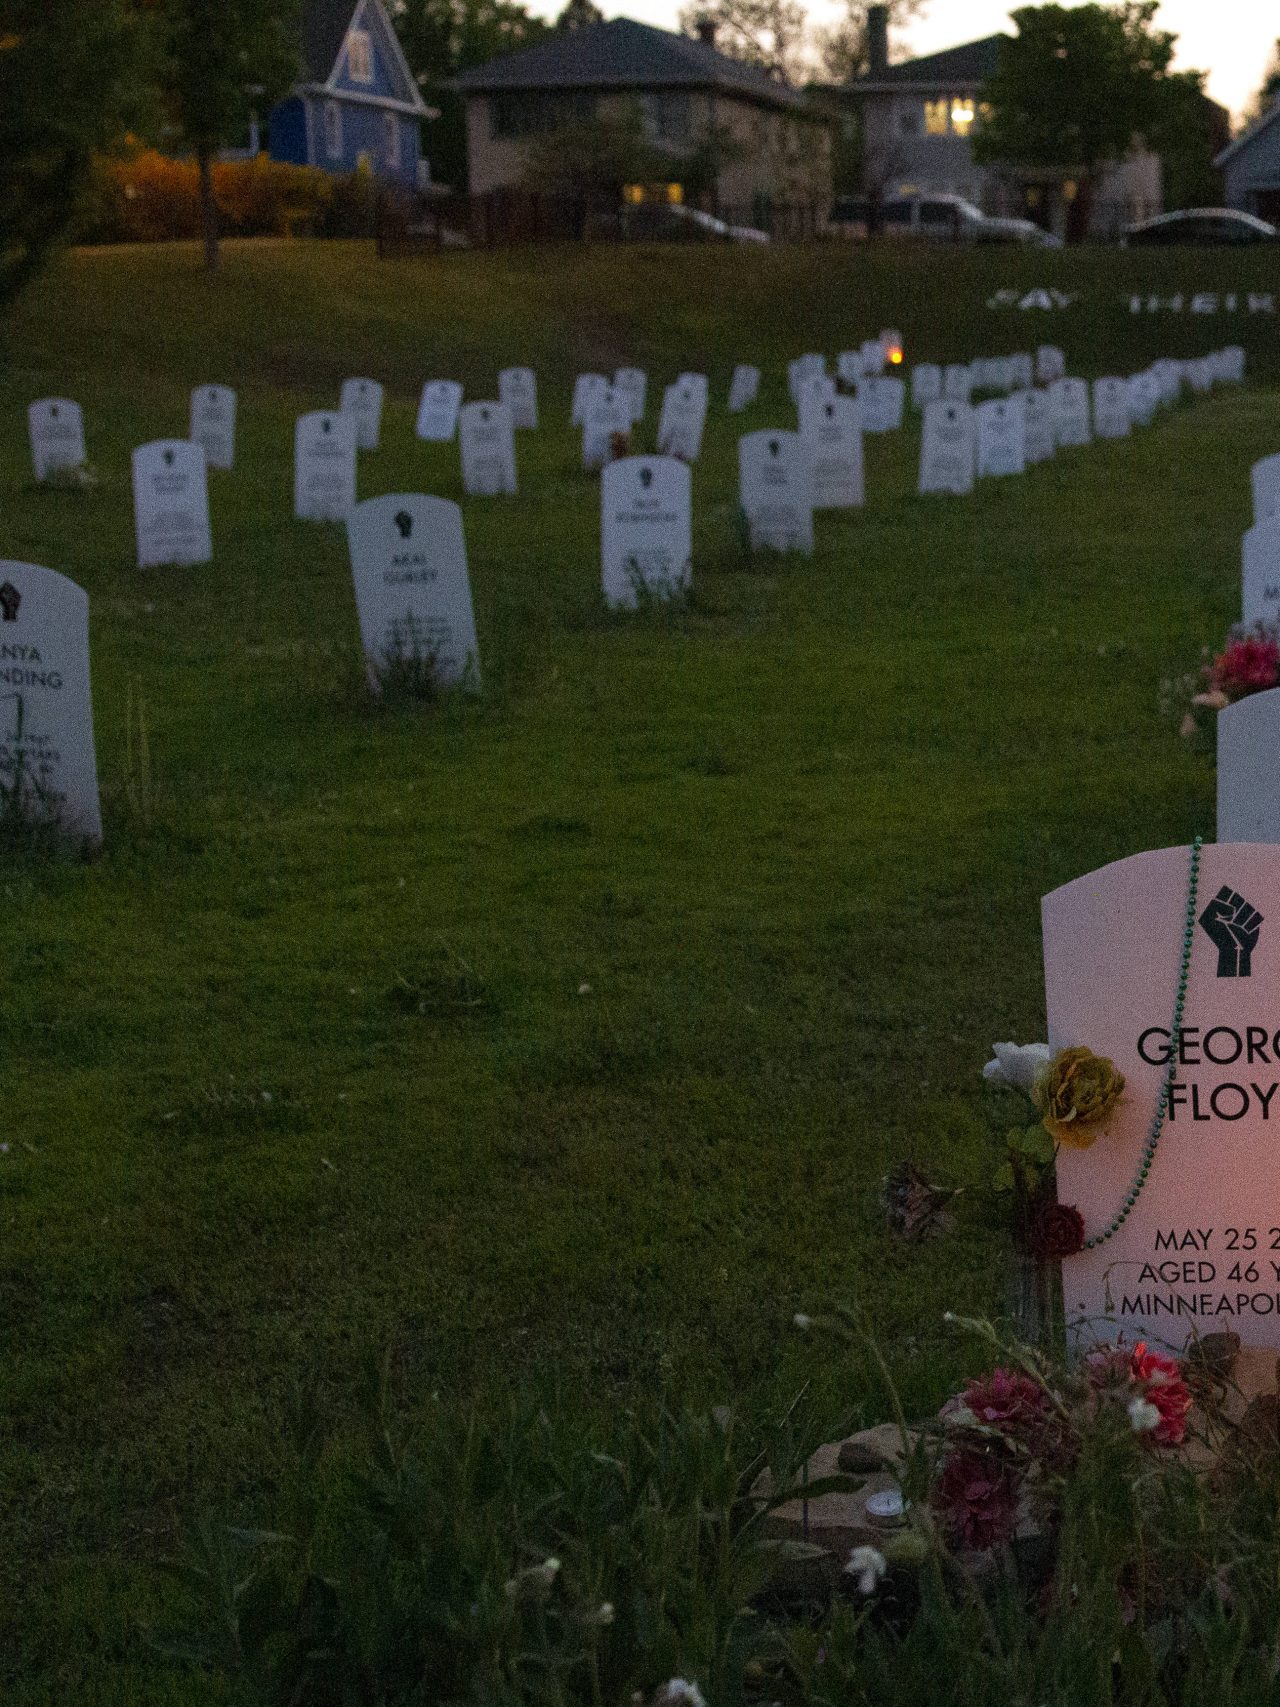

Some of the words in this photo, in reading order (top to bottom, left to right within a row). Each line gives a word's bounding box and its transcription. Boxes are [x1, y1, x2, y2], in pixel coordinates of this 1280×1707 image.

[1154, 1228, 1214, 1251] MAY
[1225, 1228, 1257, 1250] 25
[1138, 1261, 1216, 1283] AGED
[1227, 1260, 1260, 1283] 46
